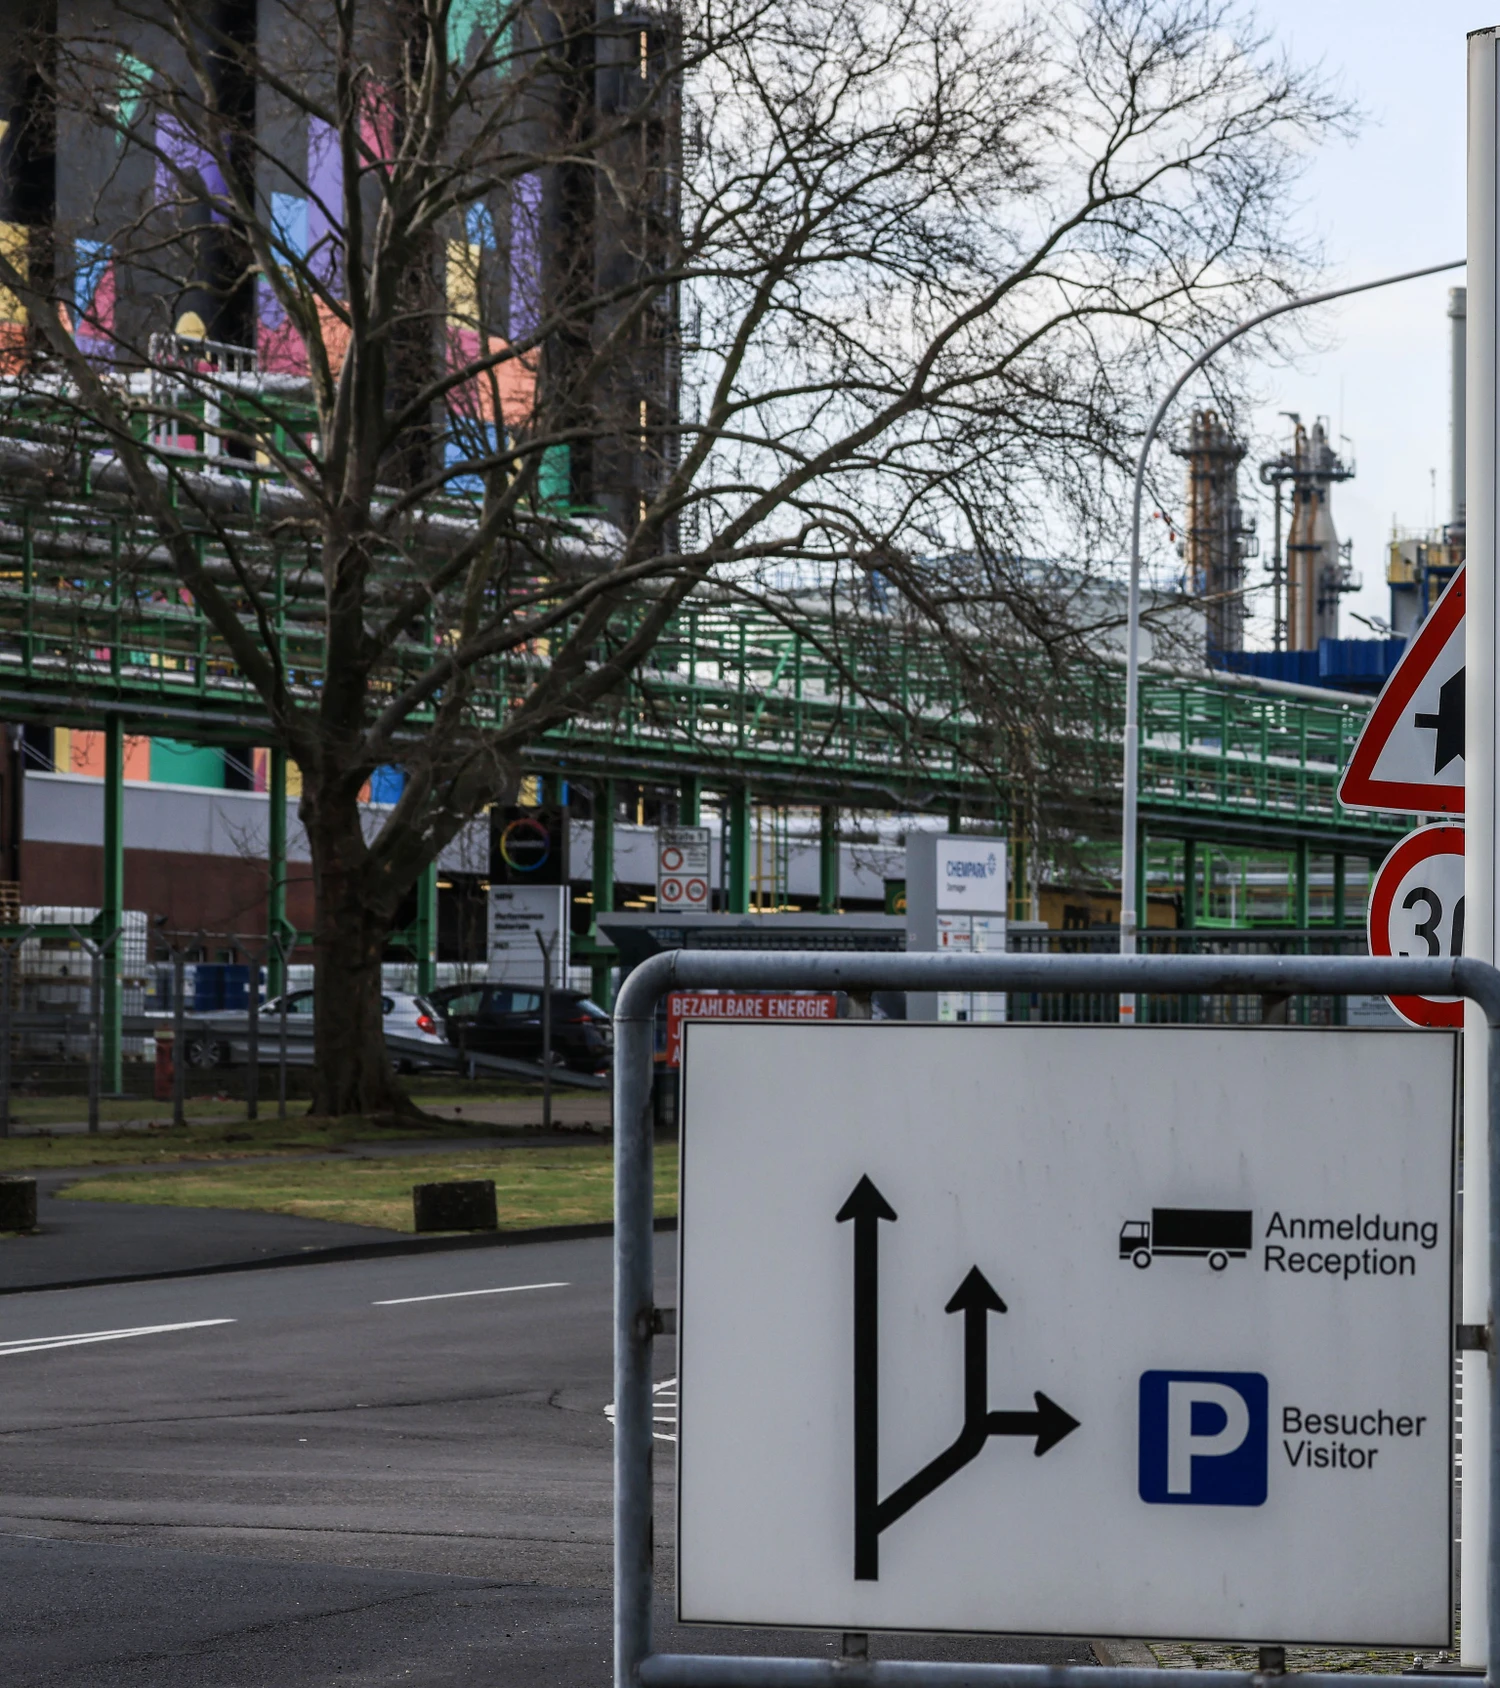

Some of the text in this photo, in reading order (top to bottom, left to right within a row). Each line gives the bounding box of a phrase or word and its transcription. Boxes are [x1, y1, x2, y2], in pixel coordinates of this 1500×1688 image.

[1400, 886, 1465, 957] 3
[672, 997, 829, 1018] BEZAHLBARE ENERGIE
[1265, 1211, 1438, 1249] Anmeldung
[1264, 1245, 1416, 1280] Reception
[1167, 1380, 1250, 1494] P
[1282, 1407, 1427, 1437] Besucher
[1283, 1440, 1379, 1469] Visitor
